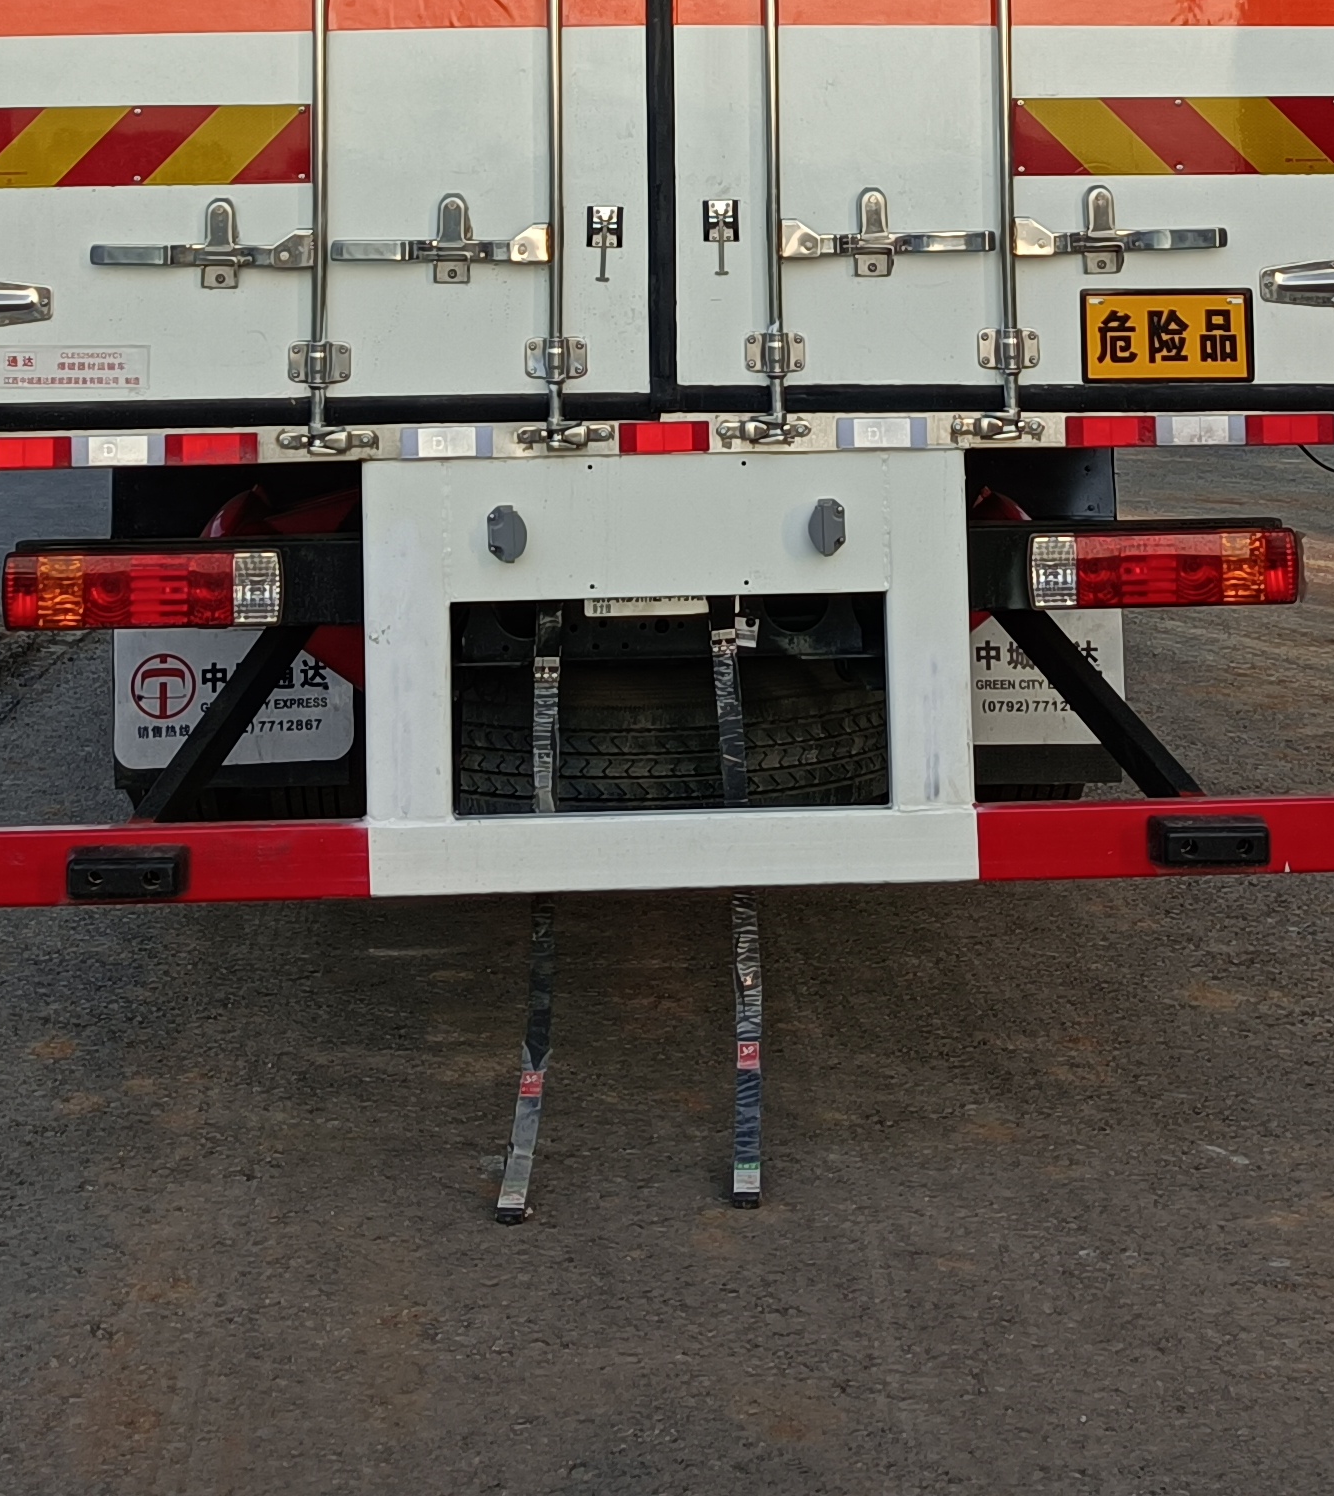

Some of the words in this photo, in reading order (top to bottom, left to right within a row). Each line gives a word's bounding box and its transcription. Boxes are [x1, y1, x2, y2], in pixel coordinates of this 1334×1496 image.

[1096, 309, 1238, 364] 危险品
[7, 355, 34, 368] 通达
[201, 660, 329, 693] 中达
[975, 679, 1016, 690] GREEN
[1019, 679, 1044, 690] CITY
[274, 697, 328, 709] EXPRESS
[982, 698, 1075, 714] (0792)7712
